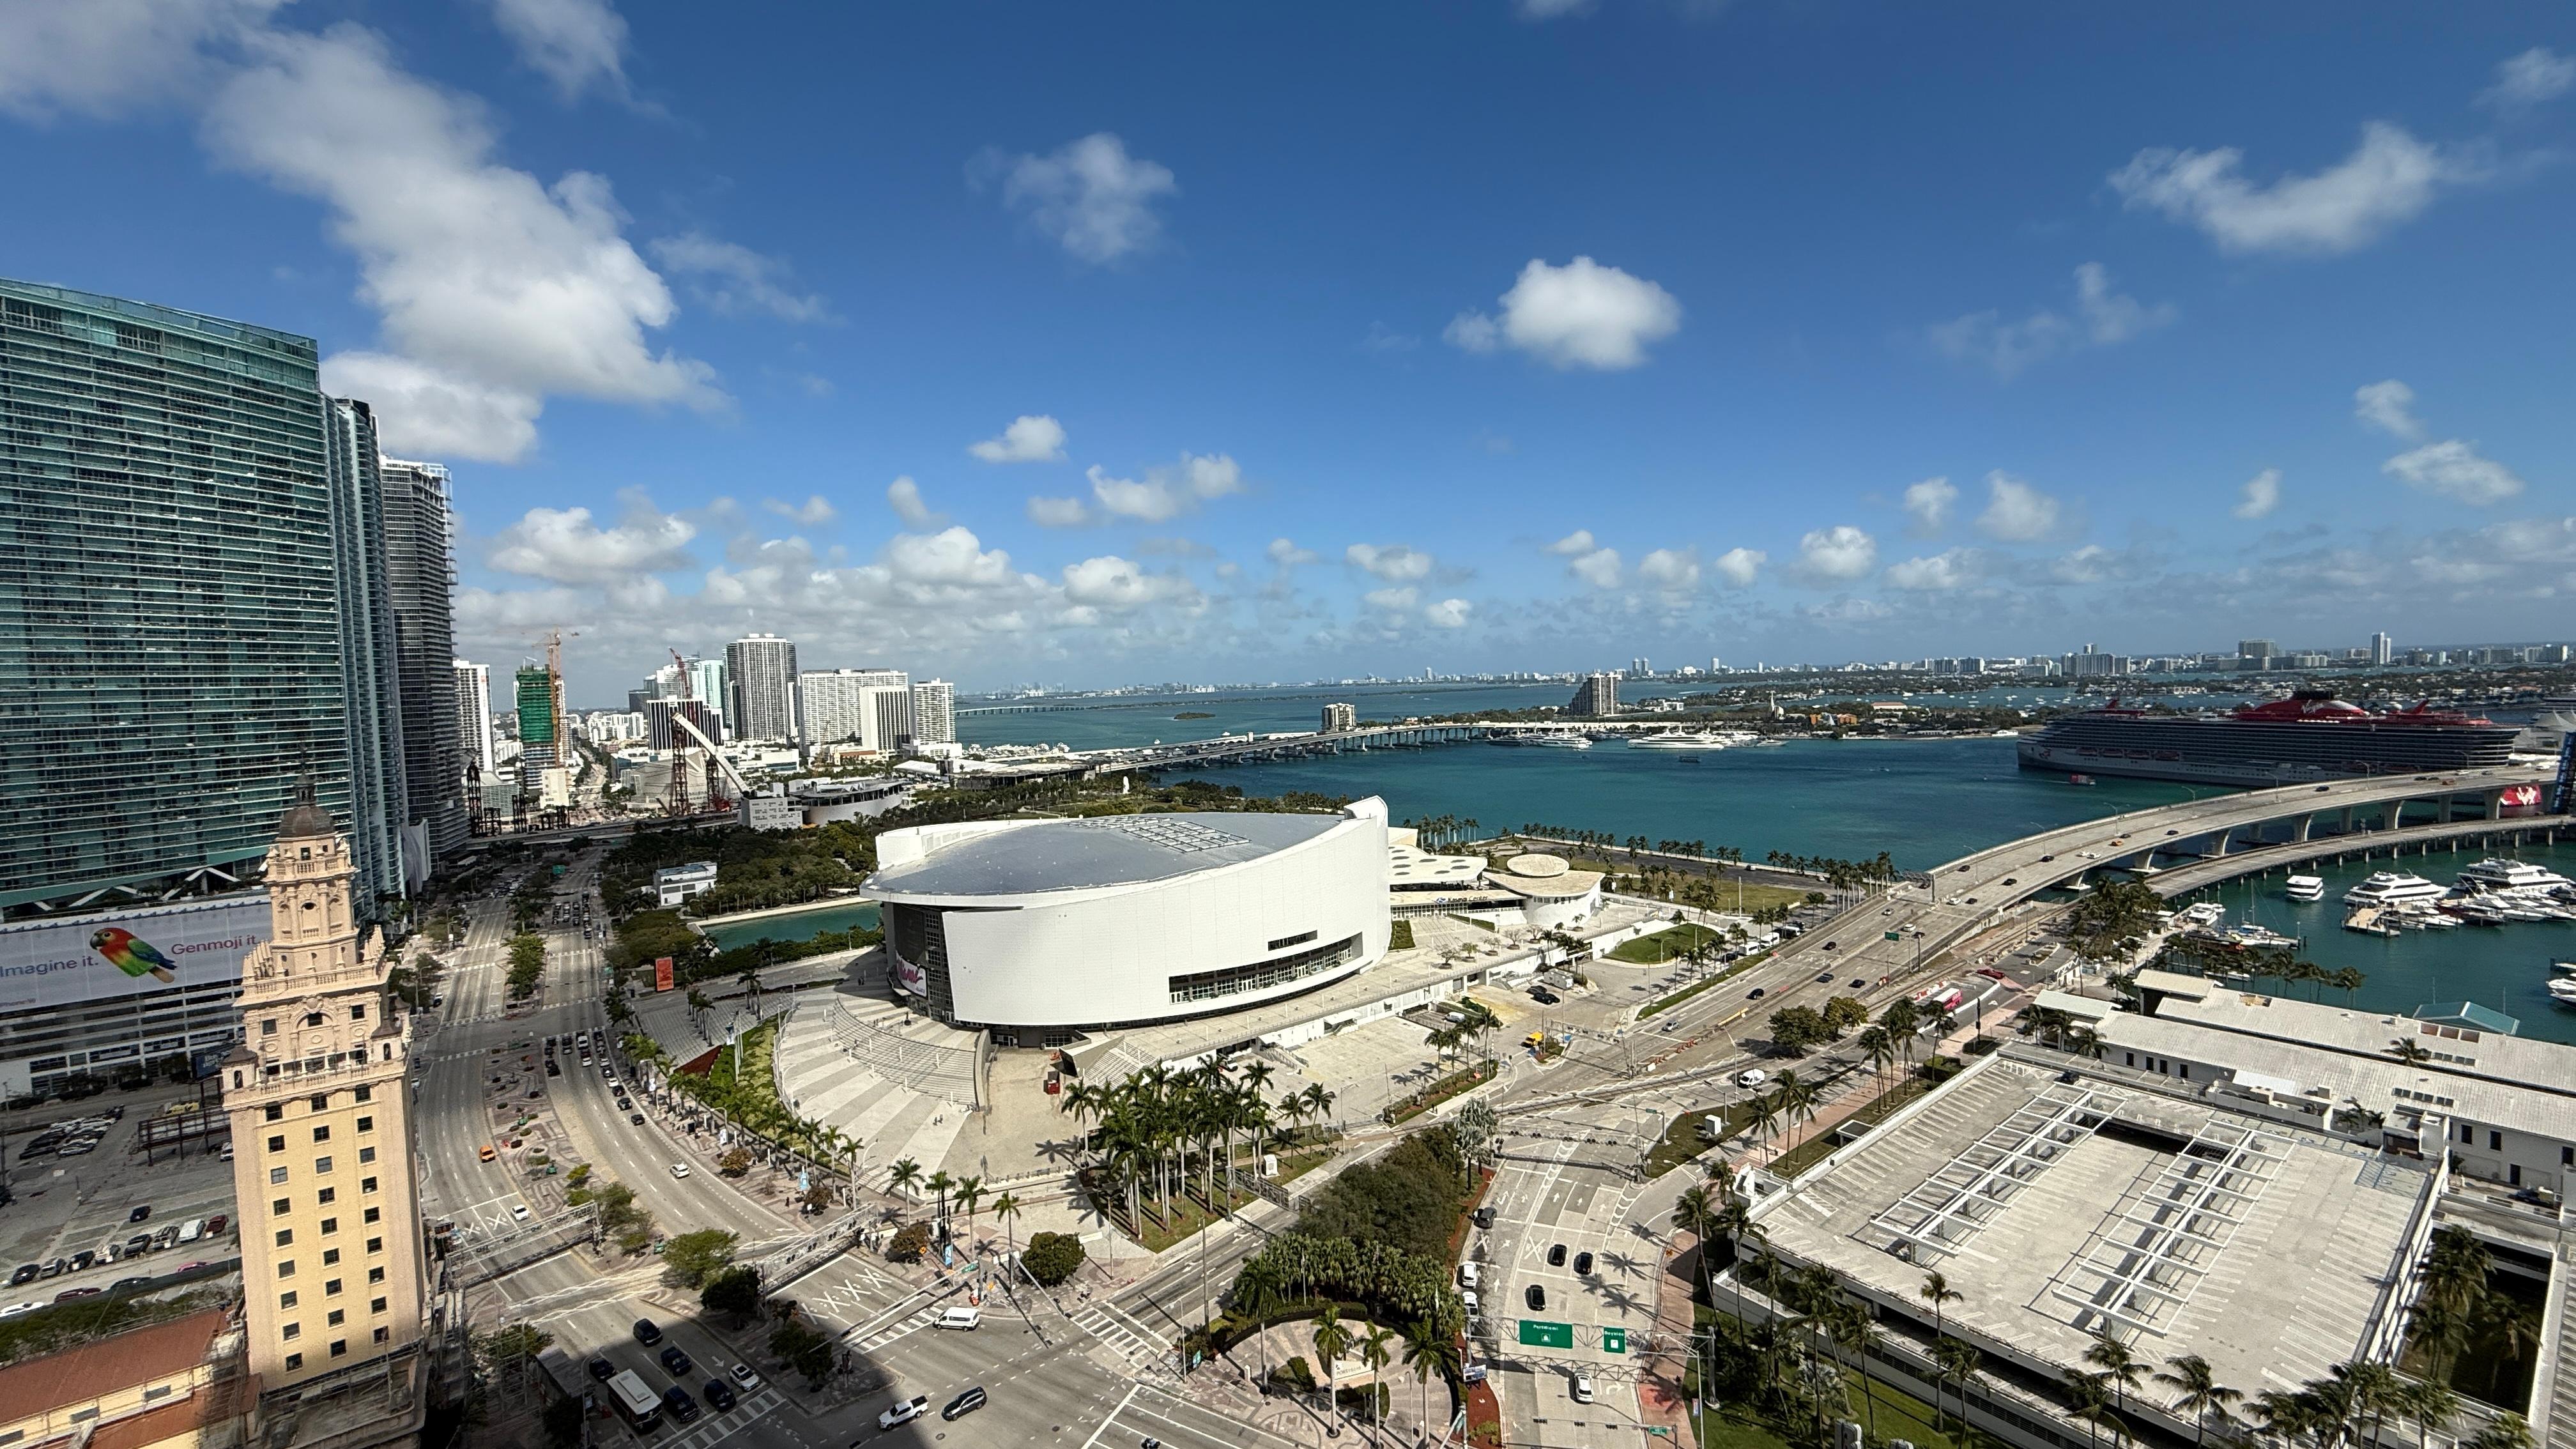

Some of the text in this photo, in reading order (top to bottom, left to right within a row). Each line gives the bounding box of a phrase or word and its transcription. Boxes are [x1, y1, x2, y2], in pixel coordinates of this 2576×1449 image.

[171, 936, 243, 954] Genmoji
[0, 956, 98, 975] Imagine it.
